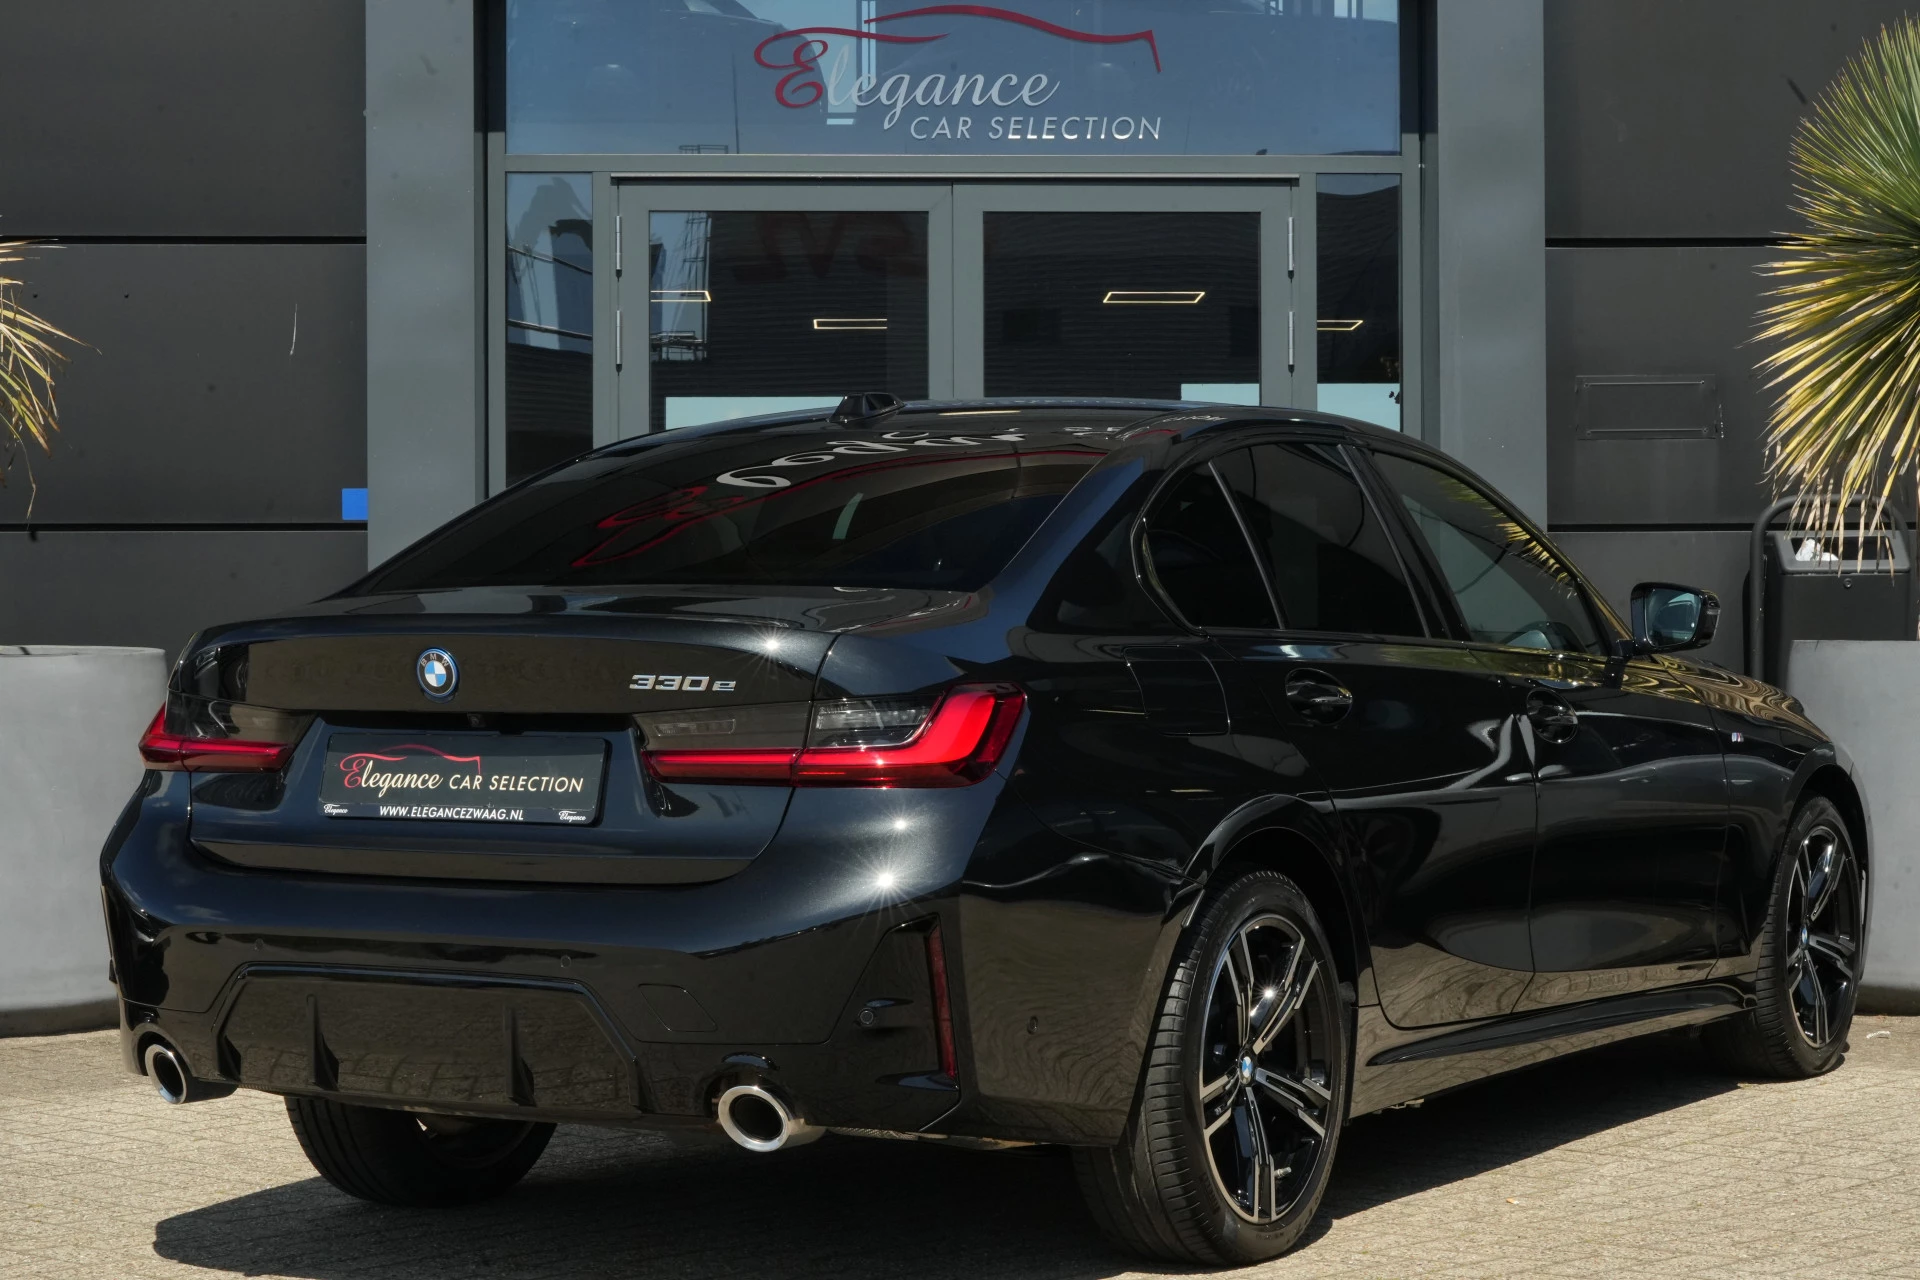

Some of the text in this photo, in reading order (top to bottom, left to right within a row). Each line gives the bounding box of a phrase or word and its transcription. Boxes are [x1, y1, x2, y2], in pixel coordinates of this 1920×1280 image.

[754, 28, 1060, 130] Elegance
[910, 116, 1161, 140] CAR SELECTION
[629, 674, 737, 692] 330e
[340, 754, 584, 798] Elegance CAR SELECTION
[323, 803, 348, 815] Elegance
[379, 805, 524, 821] WWW.ELEGANCEZWAAG.NL
[558, 810, 587, 823] Elegance
